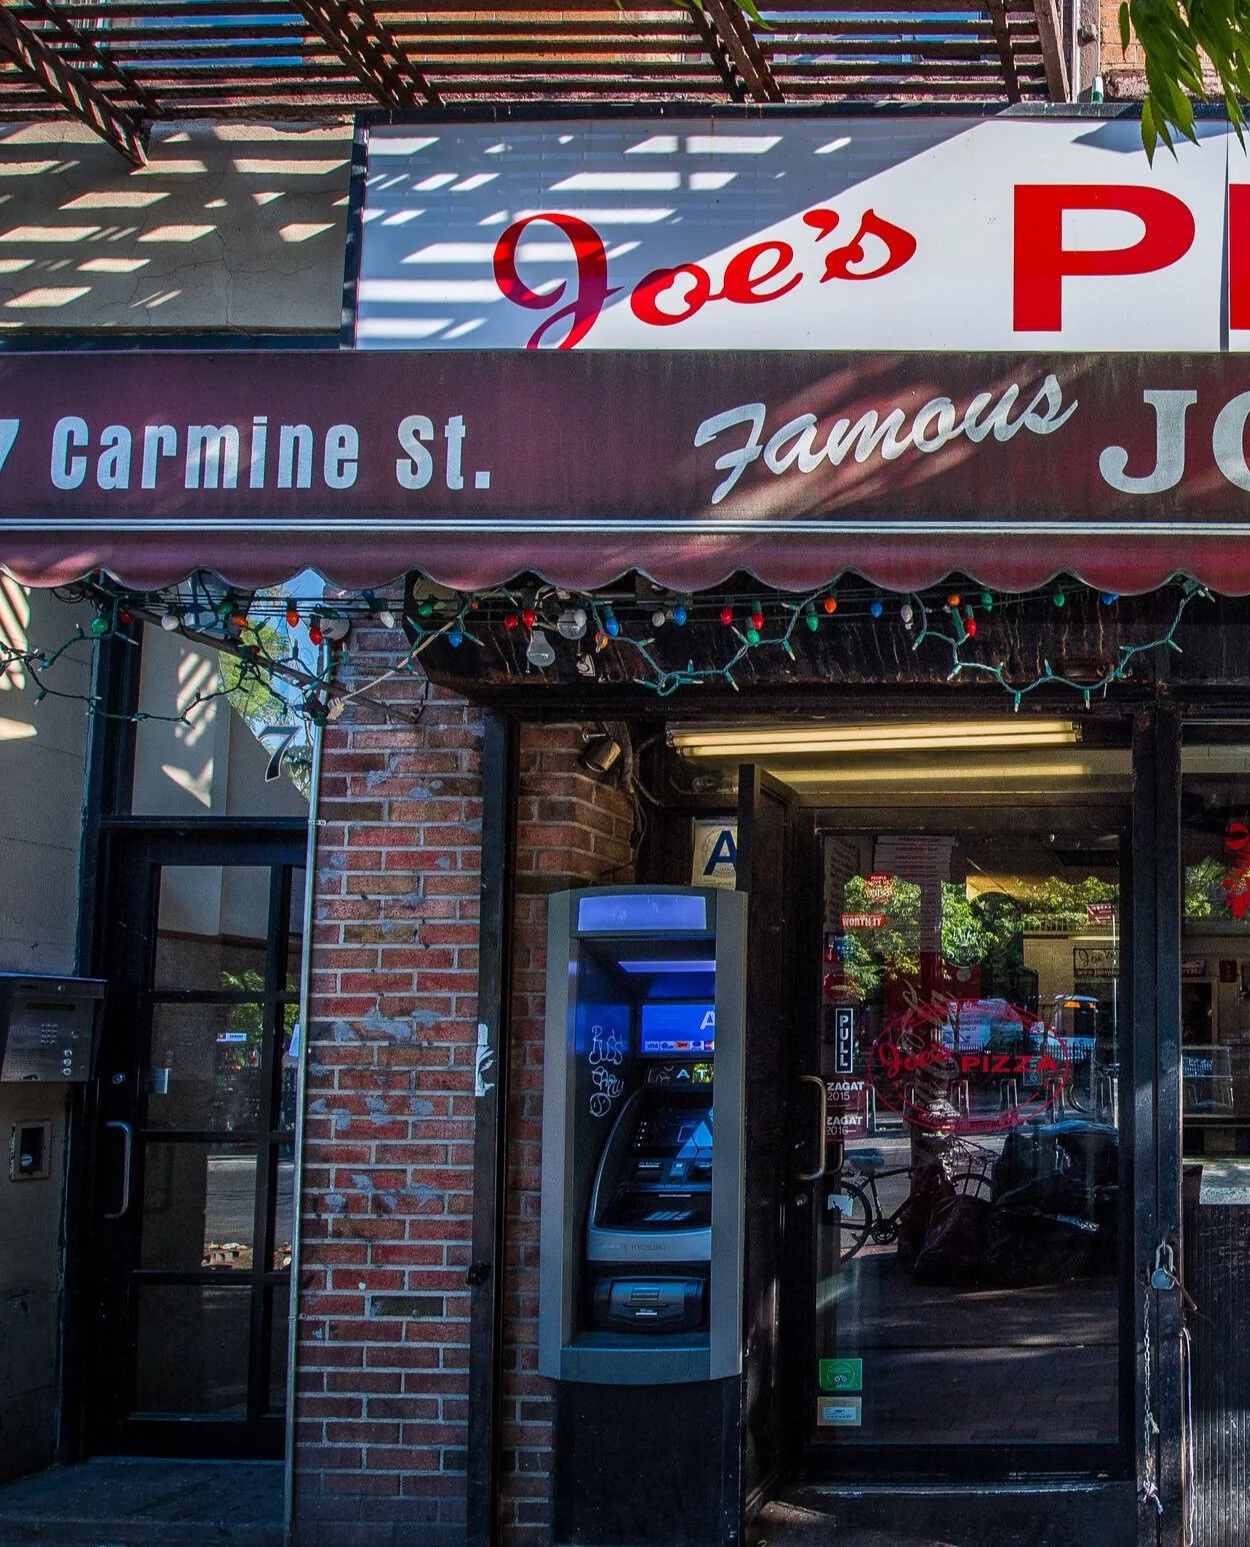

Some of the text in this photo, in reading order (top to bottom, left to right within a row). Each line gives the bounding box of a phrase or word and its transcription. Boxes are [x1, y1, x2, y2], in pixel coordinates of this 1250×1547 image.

[492, 207, 918, 350] Joe's
[50, 415, 359, 490] Carmine
[395, 414, 491, 490] St.
[693, 373, 1079, 504] Famous
[256, 725, 300, 782] 7
[703, 830, 737, 875] A
[841, 917, 882, 927] WORTH IT
[839, 1014, 849, 1068] PULL
[877, 1041, 1058, 1080] Joe's PIZZA
[826, 1081, 865, 1092] ZAGAT
[826, 1091, 850, 1102] 2015
[826, 1115, 864, 1126] ZAGAT
[826, 1125, 849, 1136] 2016
